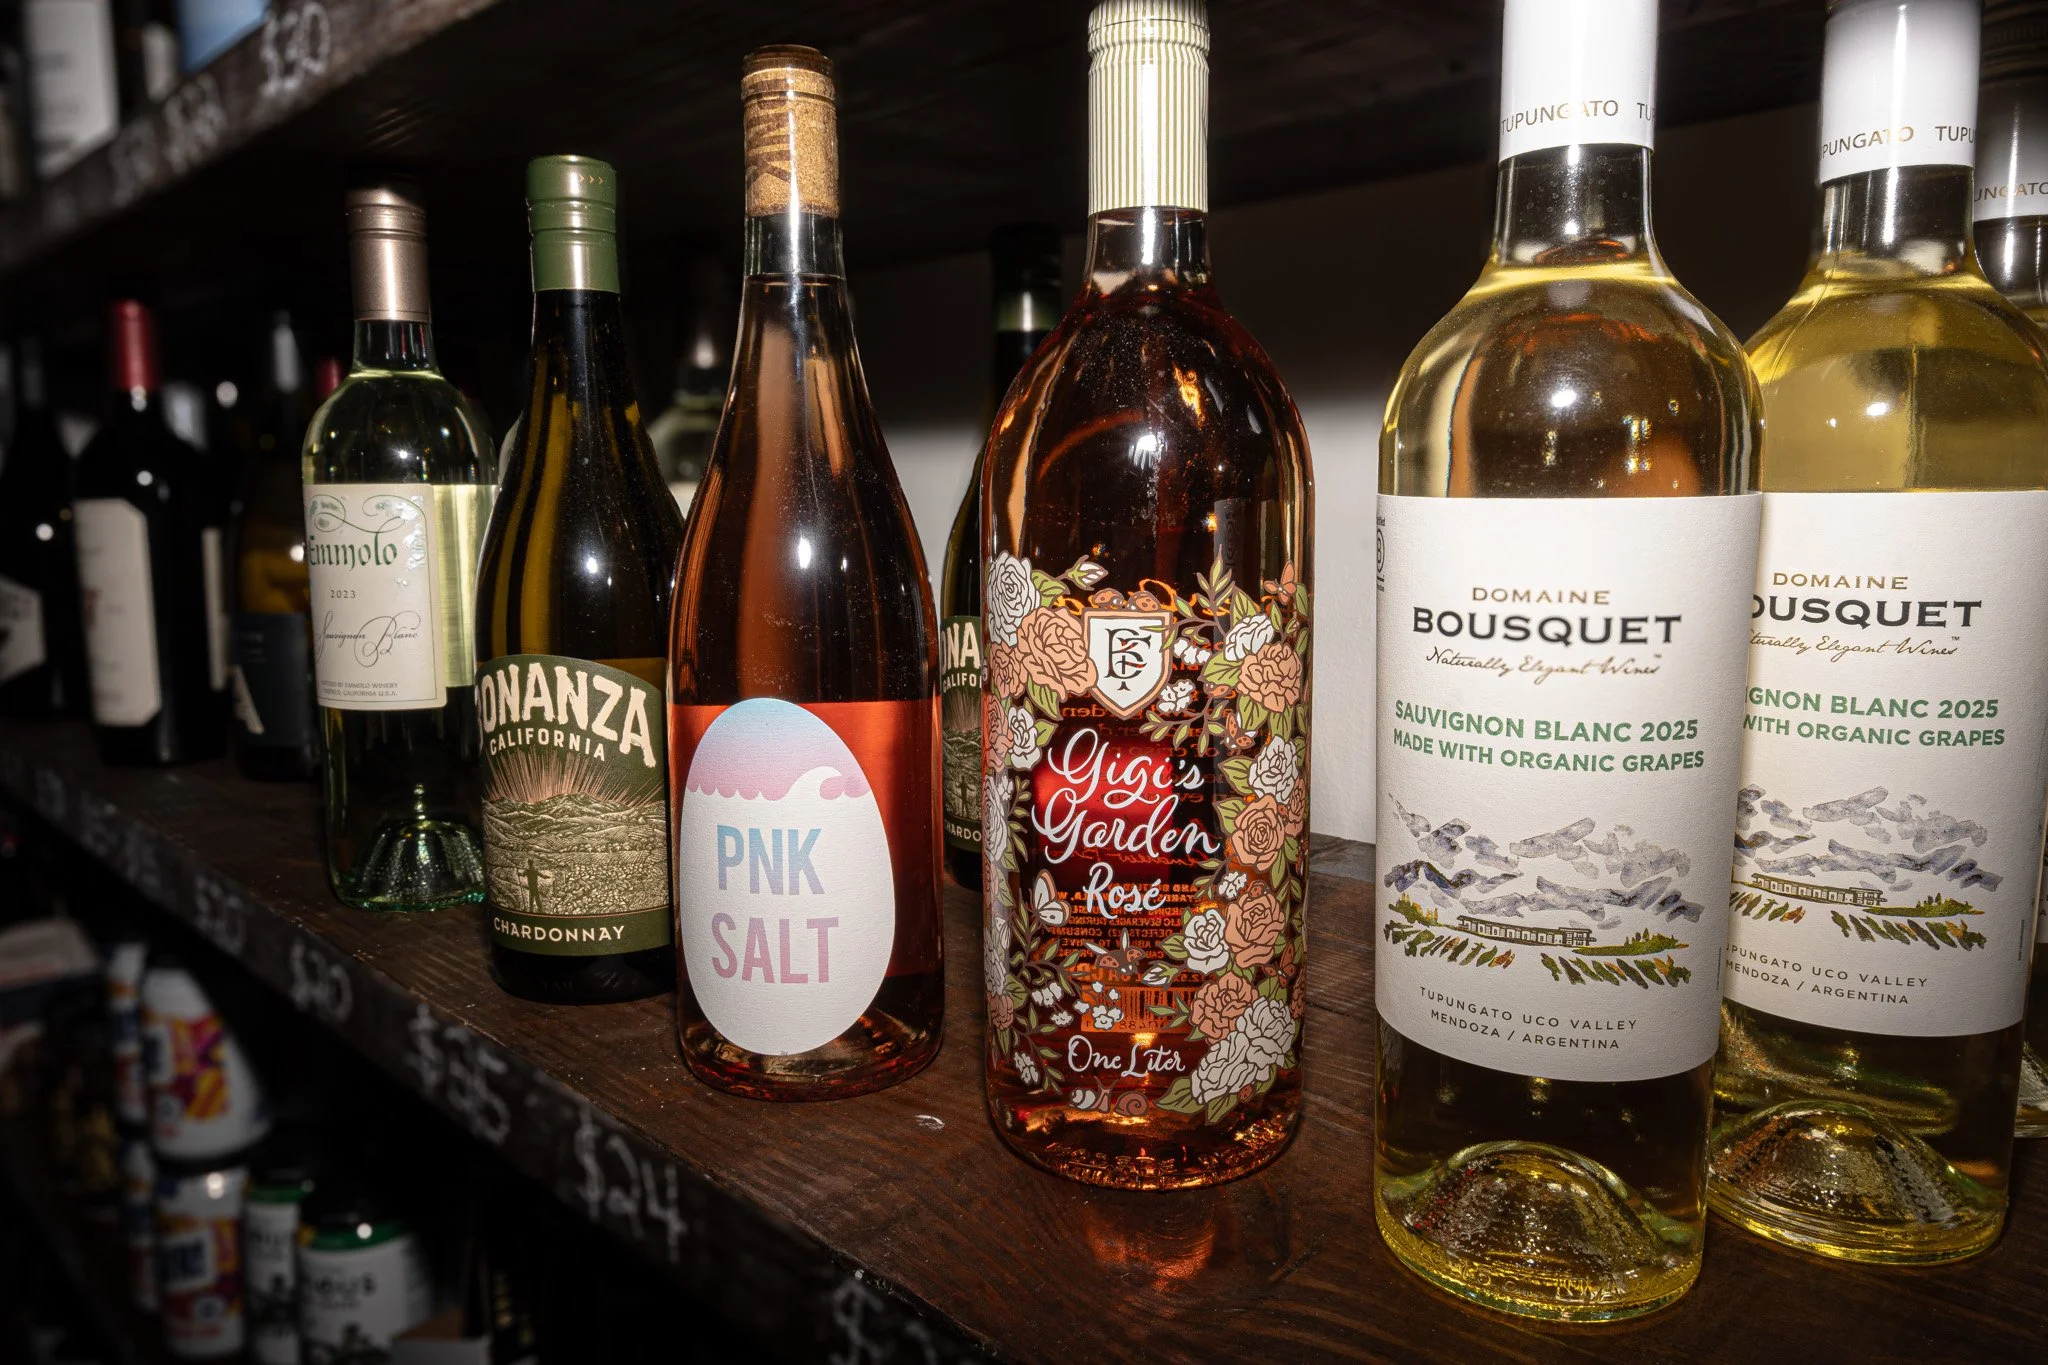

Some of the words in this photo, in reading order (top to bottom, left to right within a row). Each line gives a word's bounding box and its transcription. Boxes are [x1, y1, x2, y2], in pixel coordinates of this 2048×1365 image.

[1820, 126, 1914, 160] PUNGATO
[330, 589, 356, 599] 2023
[1472, 587, 1610, 605] DOMAINE
[1772, 572, 1908, 590] DOMAINE
[354, 610, 420, 668] Blanc
[1413, 606, 1681, 646] BOUSQUET
[1749, 629, 1811, 655] turally
[1816, 636, 1888, 663] Elegant
[1894, 637, 1958, 656] Wines
[1426, 646, 1513, 677] Naturally
[1519, 655, 1597, 685] Elegant
[1598, 655, 1661, 675] Wines
[1395, 700, 1524, 738] SAUVIGNON
[1534, 719, 1631, 742] BLANC
[1640, 719, 1698, 742] 2025
[1831, 695, 1929, 718] BLANC
[1938, 699, 1999, 719] 2025
[489, 728, 605, 761] CALIFORNIA
[1393, 728, 1433, 754] MADE
[1438, 740, 1493, 765] WITH
[1500, 749, 1615, 772] ORGANIC
[1622, 750, 1705, 772] GRAPES
[1797, 722, 1911, 745] ORGANIC
[1919, 729, 2005, 747] GRAPES
[1048, 728, 1204, 804] Gigi's
[1031, 787, 1220, 864] Garden
[716, 824, 825, 896] PNK
[1082, 862, 1167, 919] Rosé
[493, 917, 625, 942] CHARDONNAY
[711, 912, 839, 984] SALT
[1725, 959, 1790, 987] MENDOZA
[1811, 984, 1910, 1004] ARGENTINA
[1812, 966, 1848, 980] UCO
[1859, 973, 1928, 987] VALLEY
[1420, 986, 1512, 1020] TUPUNGATO
[1523, 1014, 1559, 1027] UCO
[1570, 1019, 1637, 1030] VALLEY
[1431, 1009, 1500, 1038] MENDOZA
[1522, 1033, 1619, 1049] ARGENTINA
[1068, 1035, 1121, 1072] One
[1121, 1042, 1185, 1077] Liter
